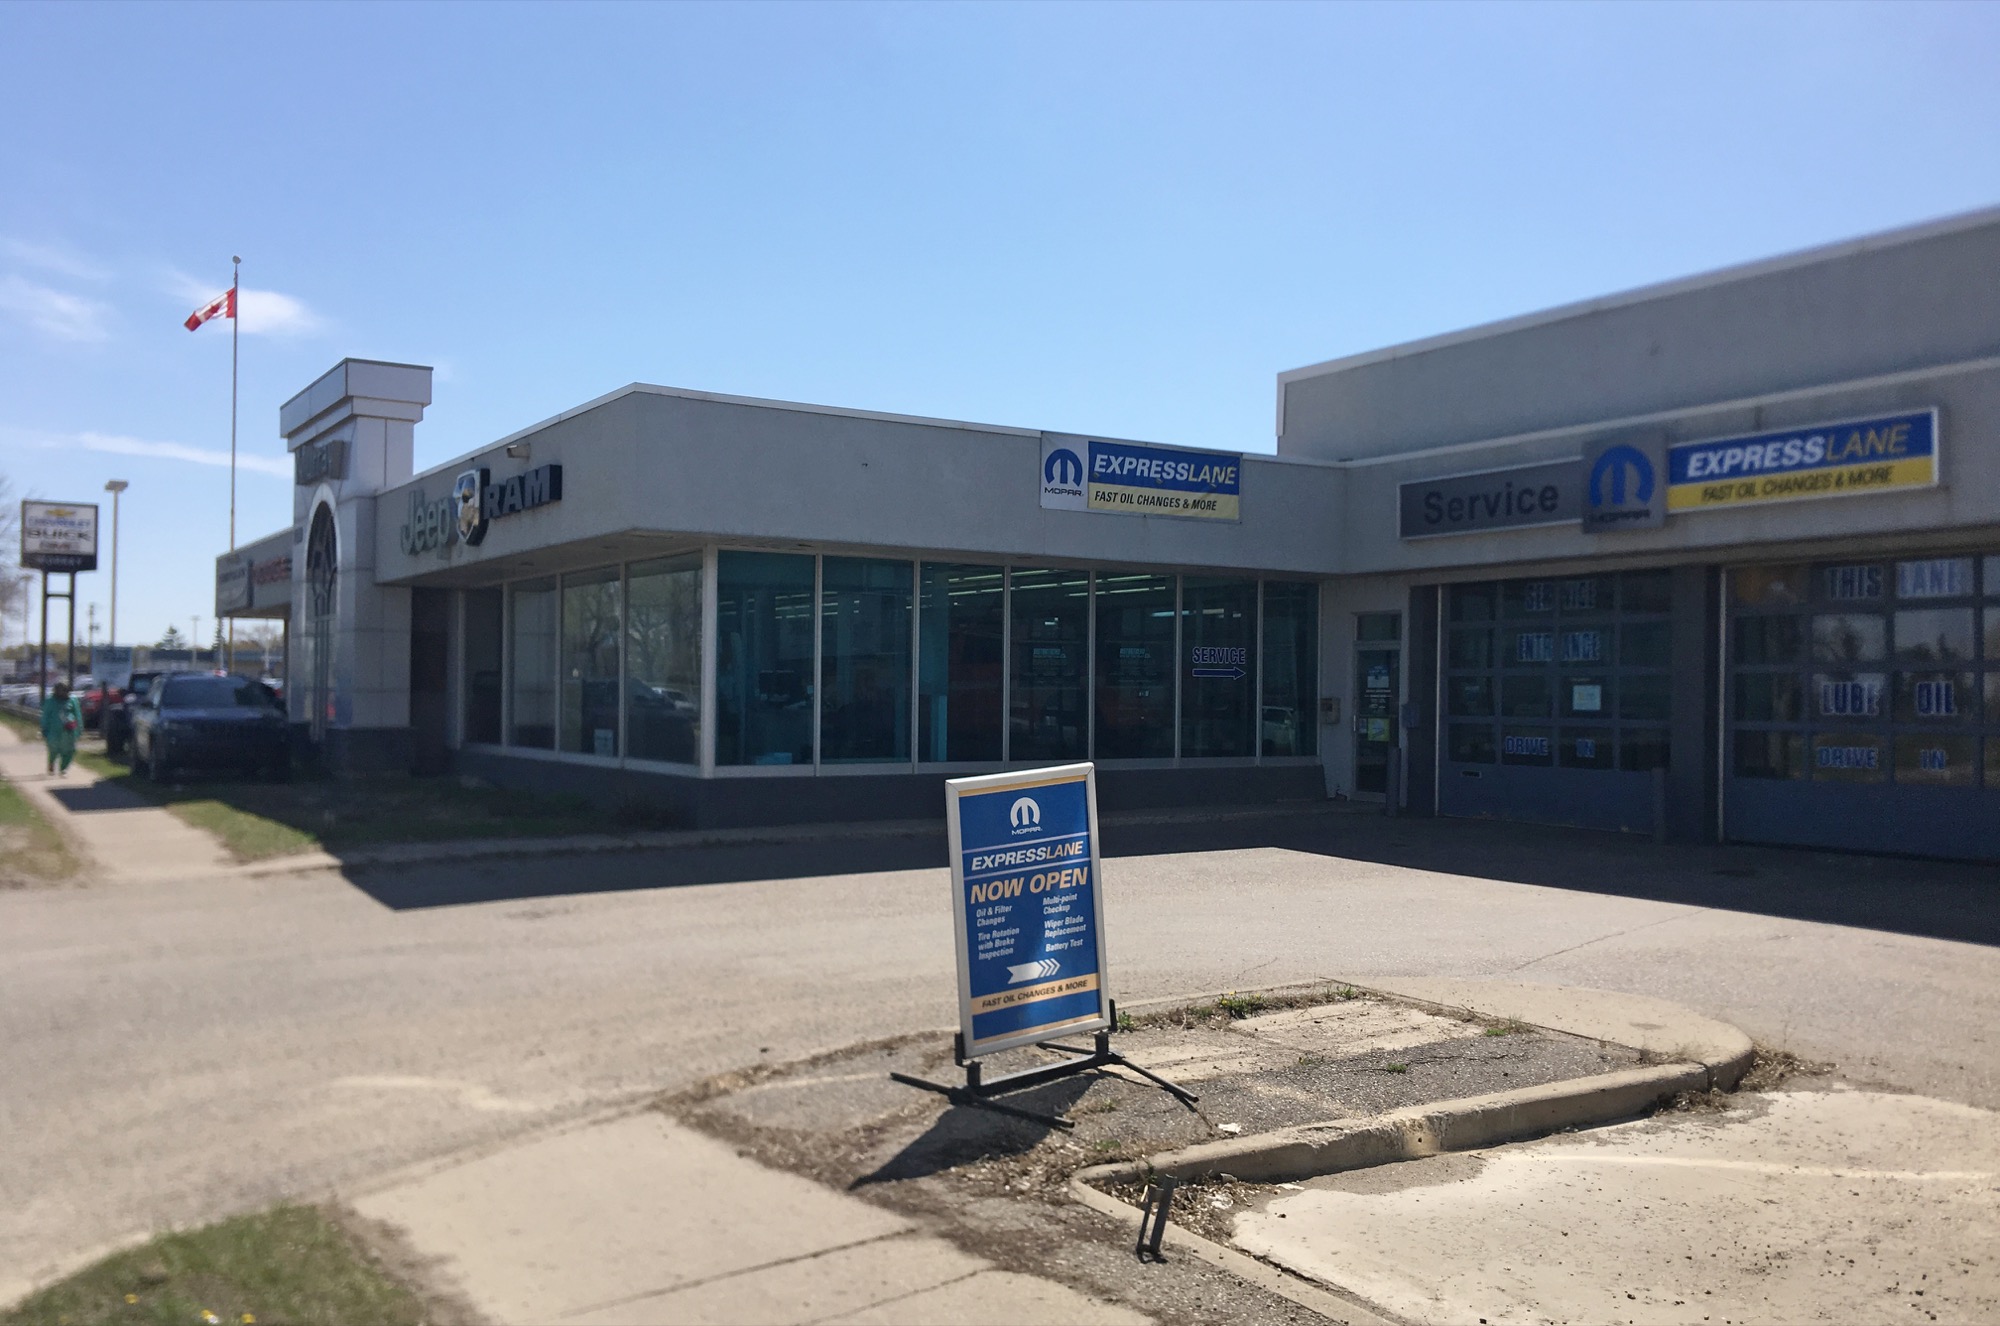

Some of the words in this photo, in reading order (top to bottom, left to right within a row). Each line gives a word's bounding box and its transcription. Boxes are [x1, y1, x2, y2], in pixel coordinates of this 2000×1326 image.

[1686, 423, 1912, 478] EXPRESSLANE
[1094, 453, 1237, 486] EXPRESSLANE
[484, 464, 556, 520] RAM
[1044, 486, 1082, 497] MOPAR
[1702, 484, 1732, 501] FAST
[1736, 481, 1757, 498] OIL
[1763, 473, 1832, 495] CHANGES
[1835, 472, 1844, 488] &
[1847, 465, 1895, 485] MORE
[1094, 490, 1119, 503] FAST
[1120, 492, 1135, 505] OIL
[1137, 494, 1181, 509] CHANGES
[1182, 498, 1190, 509] &
[1191, 499, 1217, 511] MORE
[1424, 481, 1559, 525] Service
[401, 490, 450, 558] Jeep
[1826, 564, 1883, 600] THIS
[1192, 646, 1246, 665] SERVICE
[1505, 735, 1549, 756] DRIVE
[1817, 746, 1879, 770] DRIVE
[1920, 749, 1947, 771] IN
[1011, 826, 1042, 836] MOPAR
[971, 841, 1084, 872] EXPRESSLANE
[970, 877, 1025, 905] NOW
[1029, 867, 1089, 894] OPEN
[1043, 893, 1078, 905] Multi-point
[976, 908, 987, 918] Oil
[987, 906, 993, 916] &
[994, 905, 1013, 915] Filter
[1043, 904, 1071, 915] Checkup
[977, 916, 1006, 927] Changes
[1044, 919, 1065, 930] Wiper
[1065, 915, 1084, 925] Blade
[1045, 924, 1087, 938] Replacement
[978, 932, 991, 942] Tire
[992, 928, 1020, 939] Rotation
[978, 940, 994, 951] with
[994, 937, 1015, 948] Brake
[1046, 942, 1069, 952] Battery
[1070, 938, 1083, 948] Test
[979, 947, 1014, 961] Inspection
[982, 996, 1002, 1008] FAST
[1003, 993, 1016, 1004] OIL
[1017, 986, 1056, 1000] CHANGES
[1057, 984, 1064, 993] &
[1064, 979, 1088, 991] MORE
